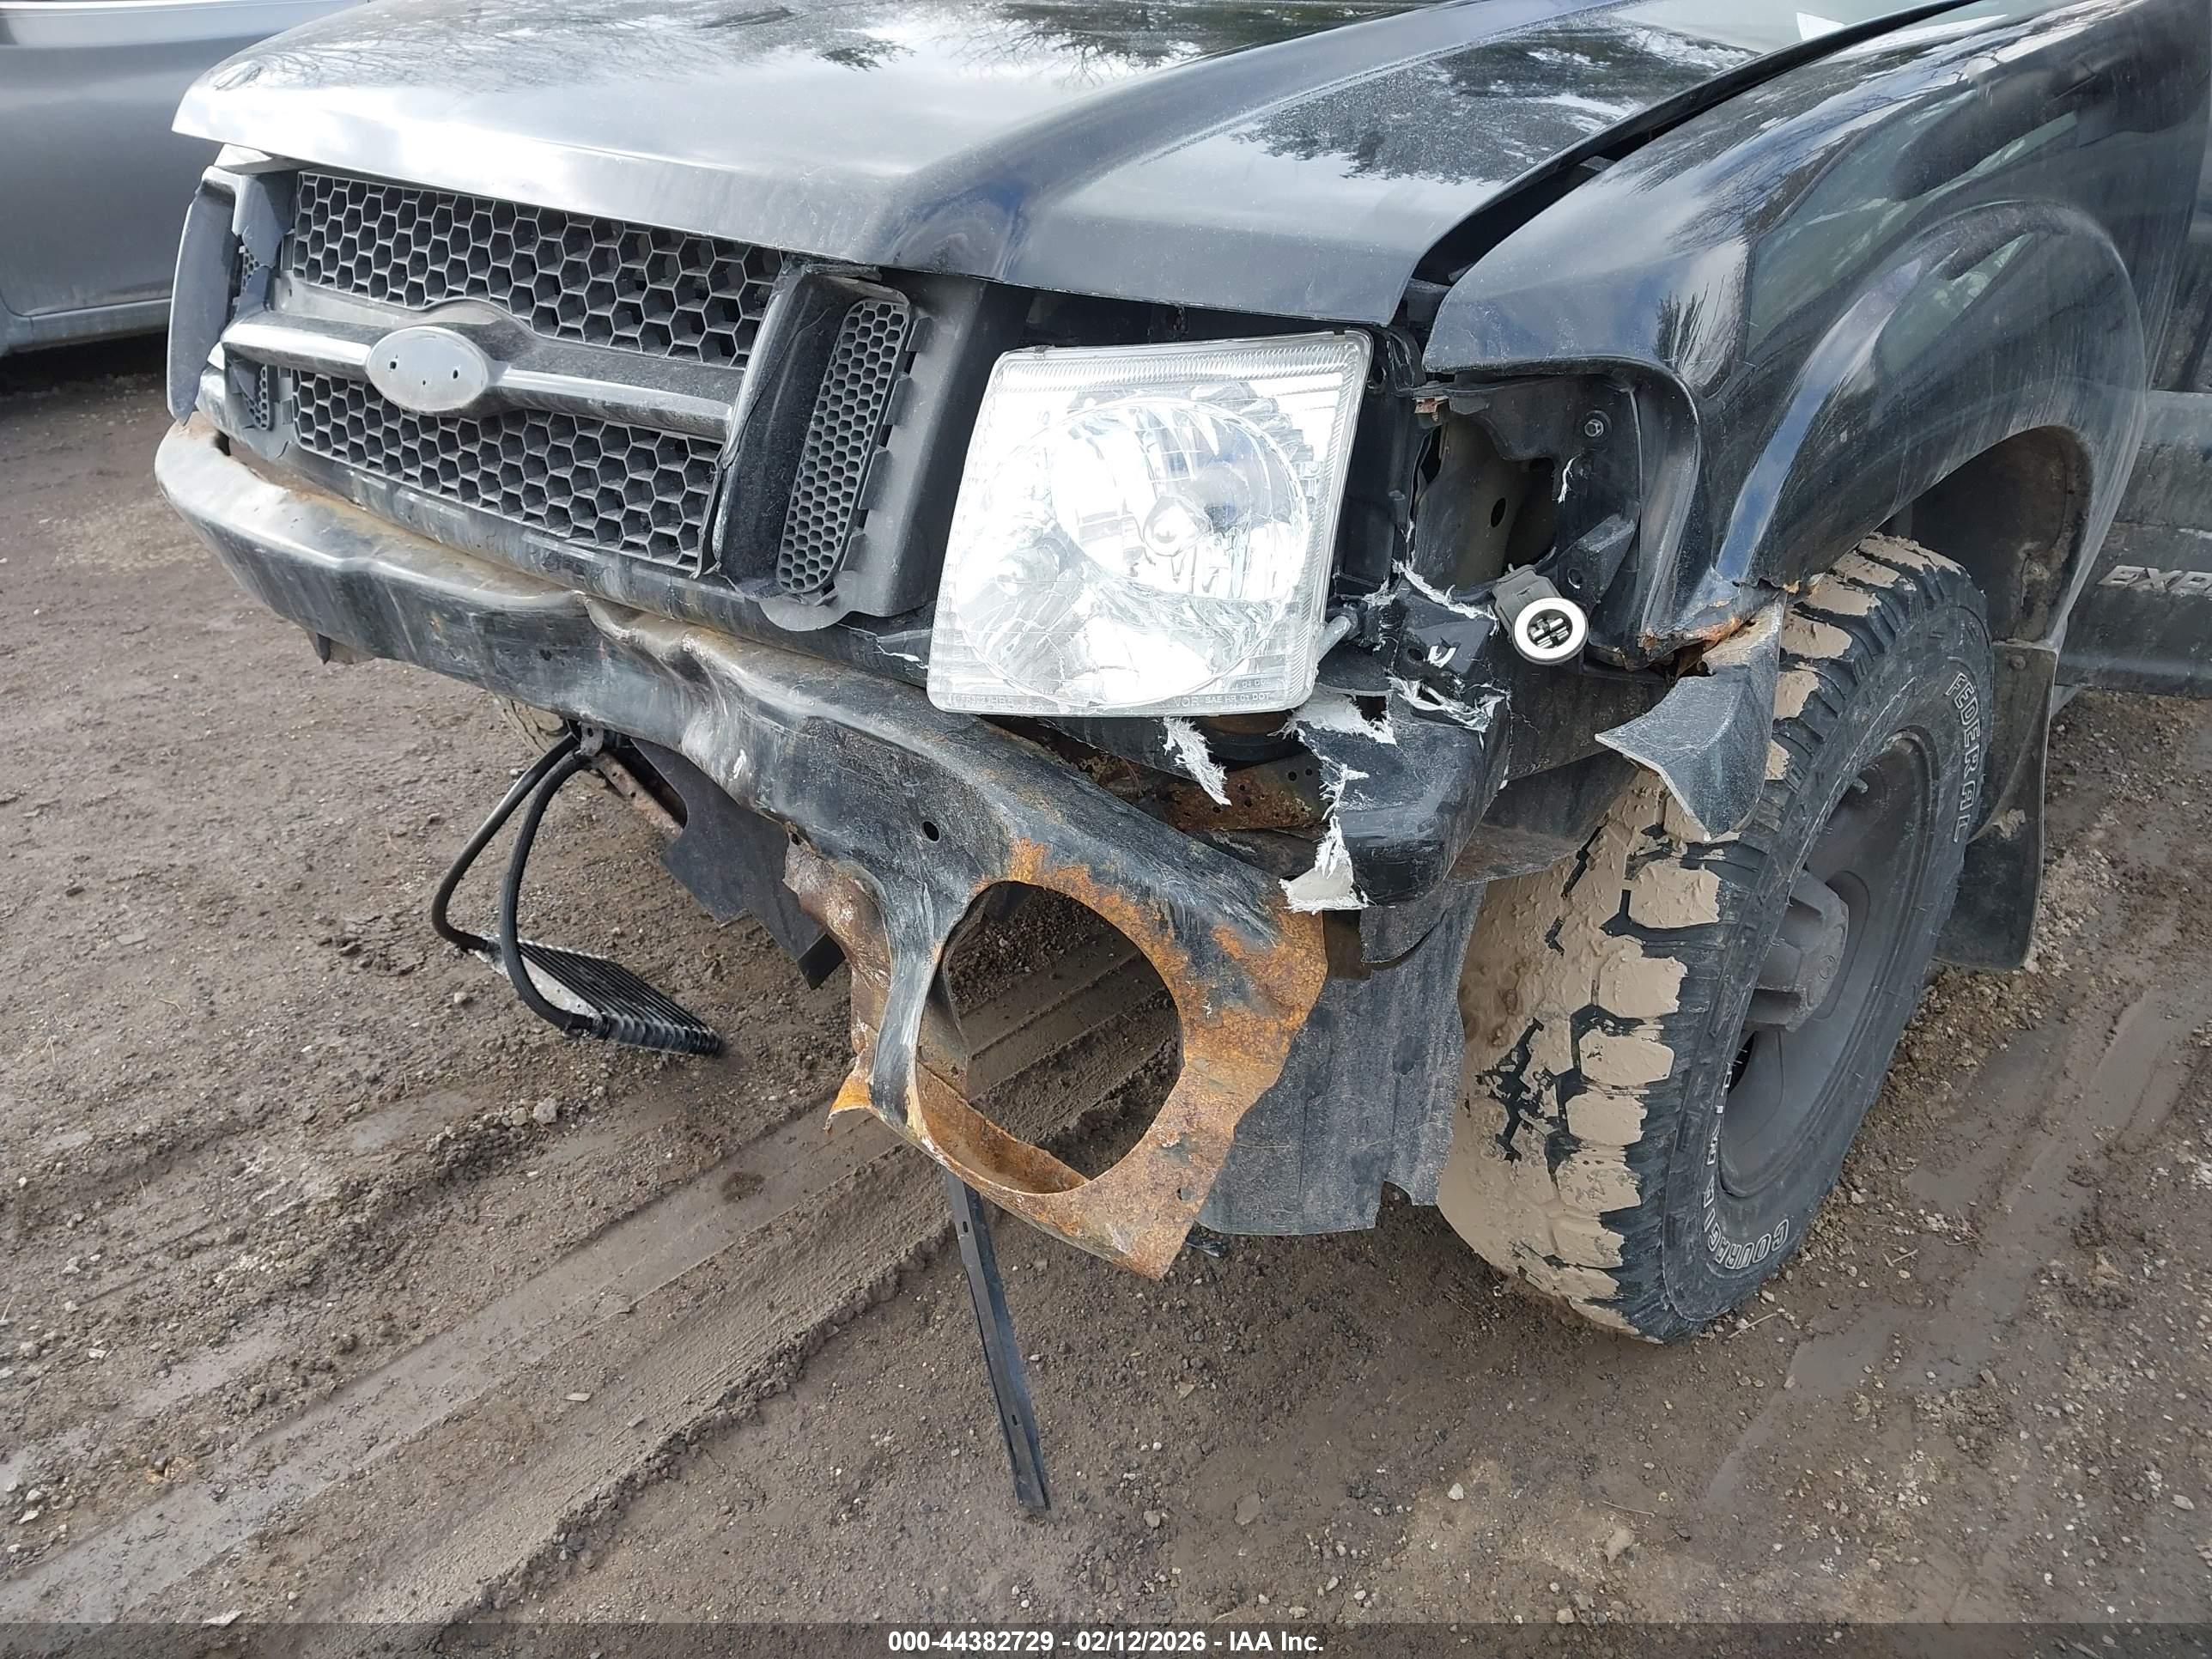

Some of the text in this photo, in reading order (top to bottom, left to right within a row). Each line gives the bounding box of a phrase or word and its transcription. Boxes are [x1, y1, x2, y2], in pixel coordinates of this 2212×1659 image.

[2097, 565, 2212, 596] EXP
[1251, 692, 1271, 701] DOT
[1944, 672, 1981, 843] FEDERAL
[1703, 1176, 1790, 1270] COURAGIA
